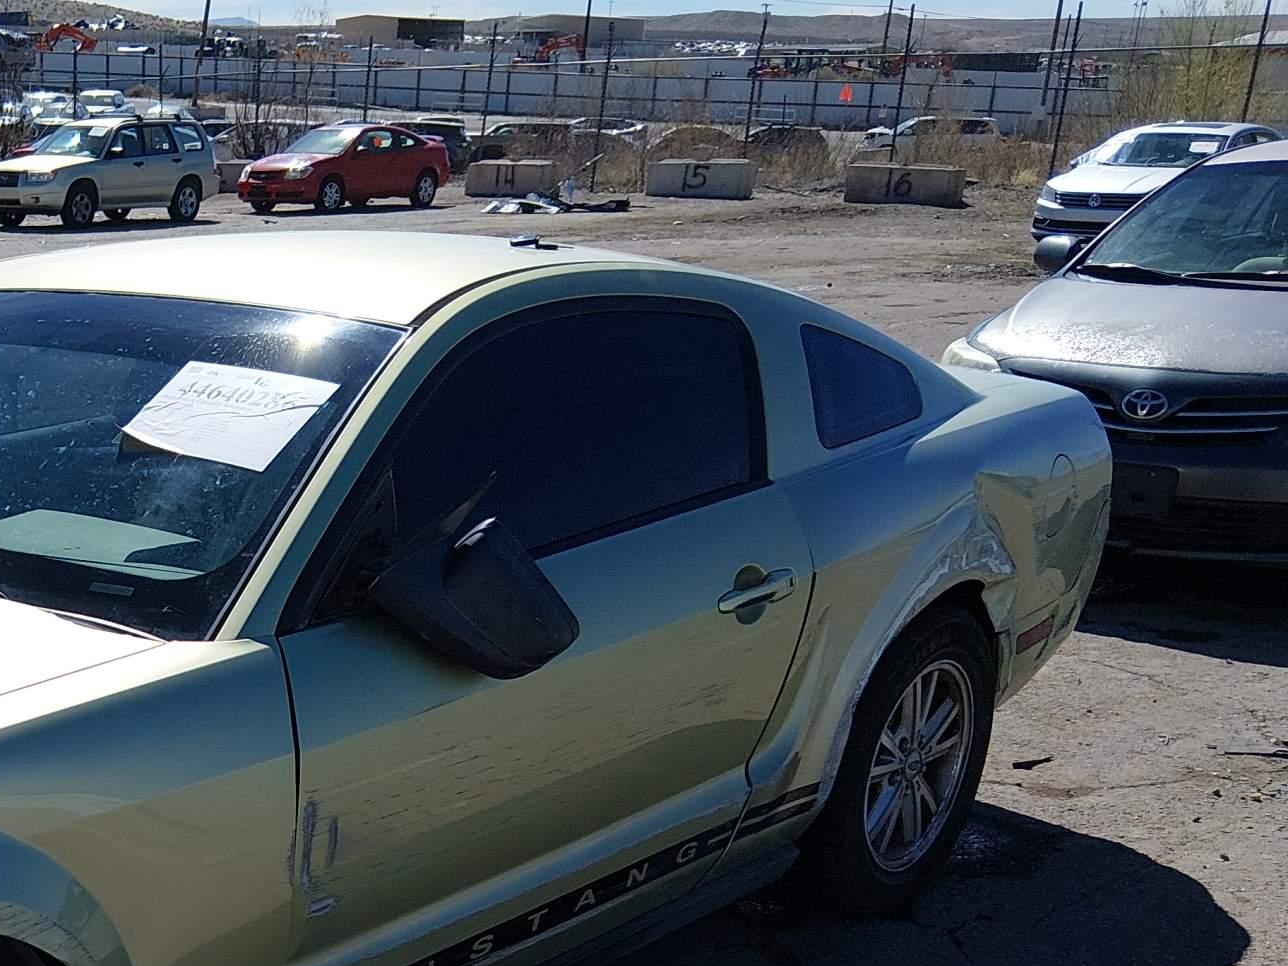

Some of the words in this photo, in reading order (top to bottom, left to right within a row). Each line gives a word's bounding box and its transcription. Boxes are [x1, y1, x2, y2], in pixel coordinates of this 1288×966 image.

[495, 164, 515, 190] 14
[681, 163, 710, 192] 15
[885, 168, 914, 197] 16
